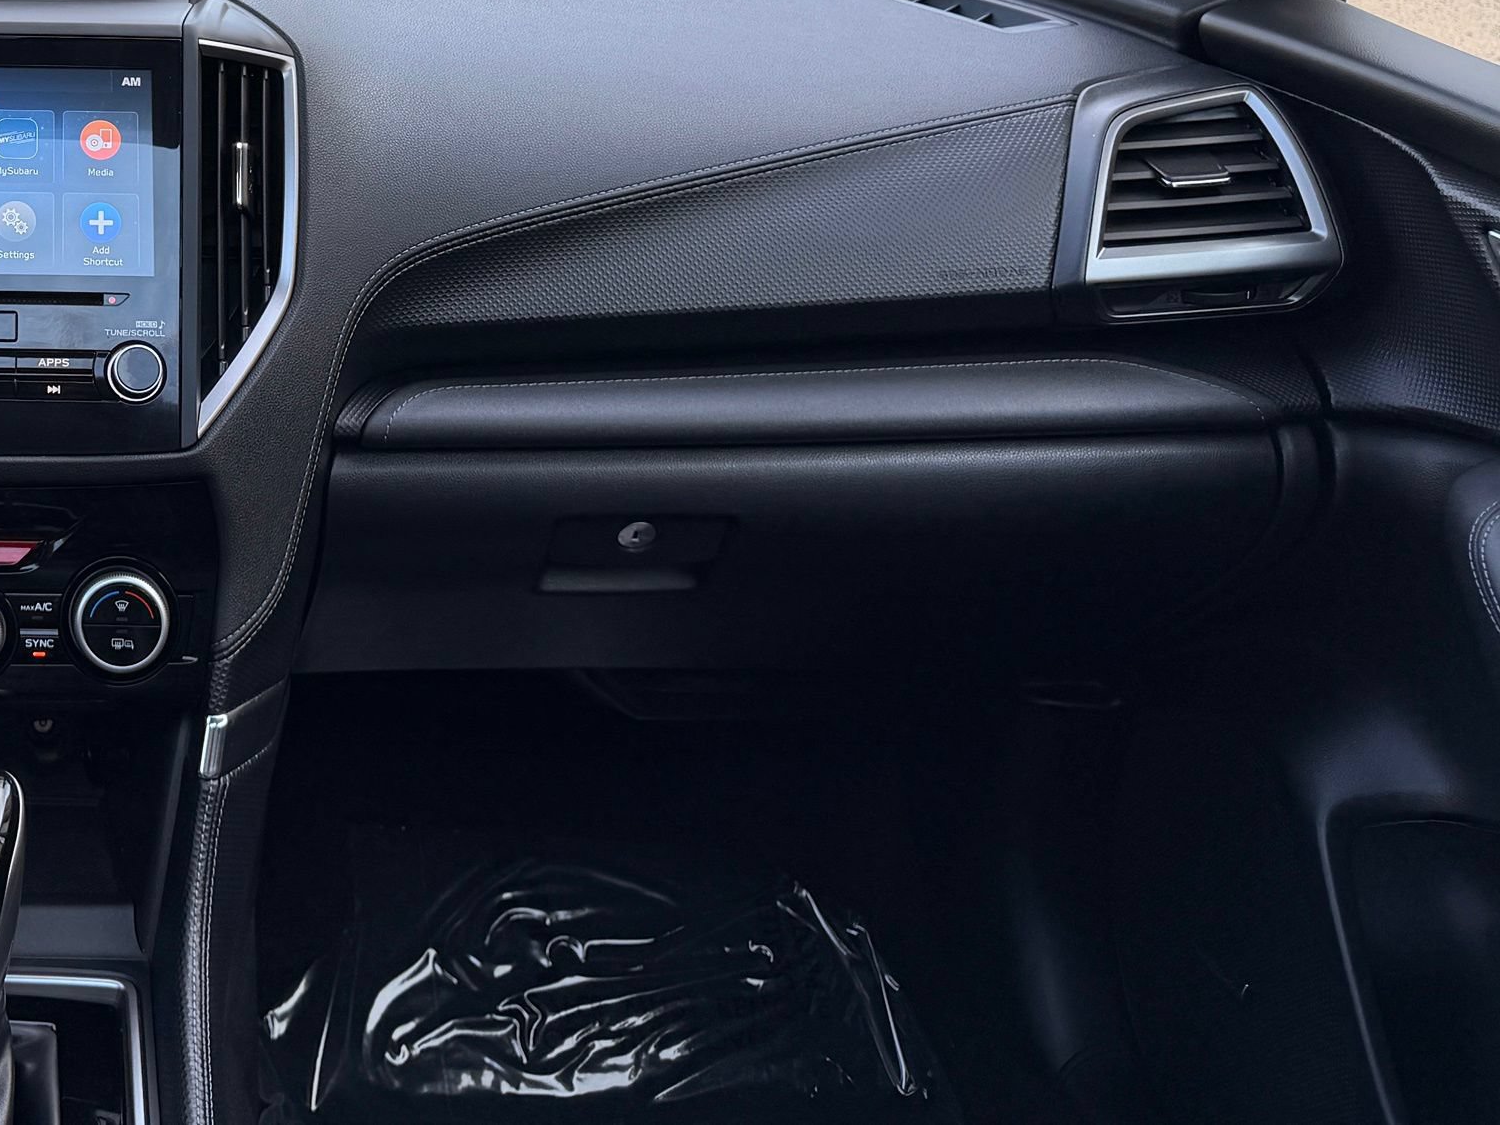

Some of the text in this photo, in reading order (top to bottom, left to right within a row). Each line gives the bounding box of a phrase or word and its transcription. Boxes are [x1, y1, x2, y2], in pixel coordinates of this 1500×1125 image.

[121, 76, 141, 87] AM
[87, 167, 114, 177] Media
[92, 246, 110, 255] Add
[83, 257, 124, 267] Shortcut
[104, 329, 166, 337] TUNE/SCROLL
[38, 357, 70, 368] APPS
[34, 602, 52, 612] A/C
[25, 639, 54, 649] SYNC
